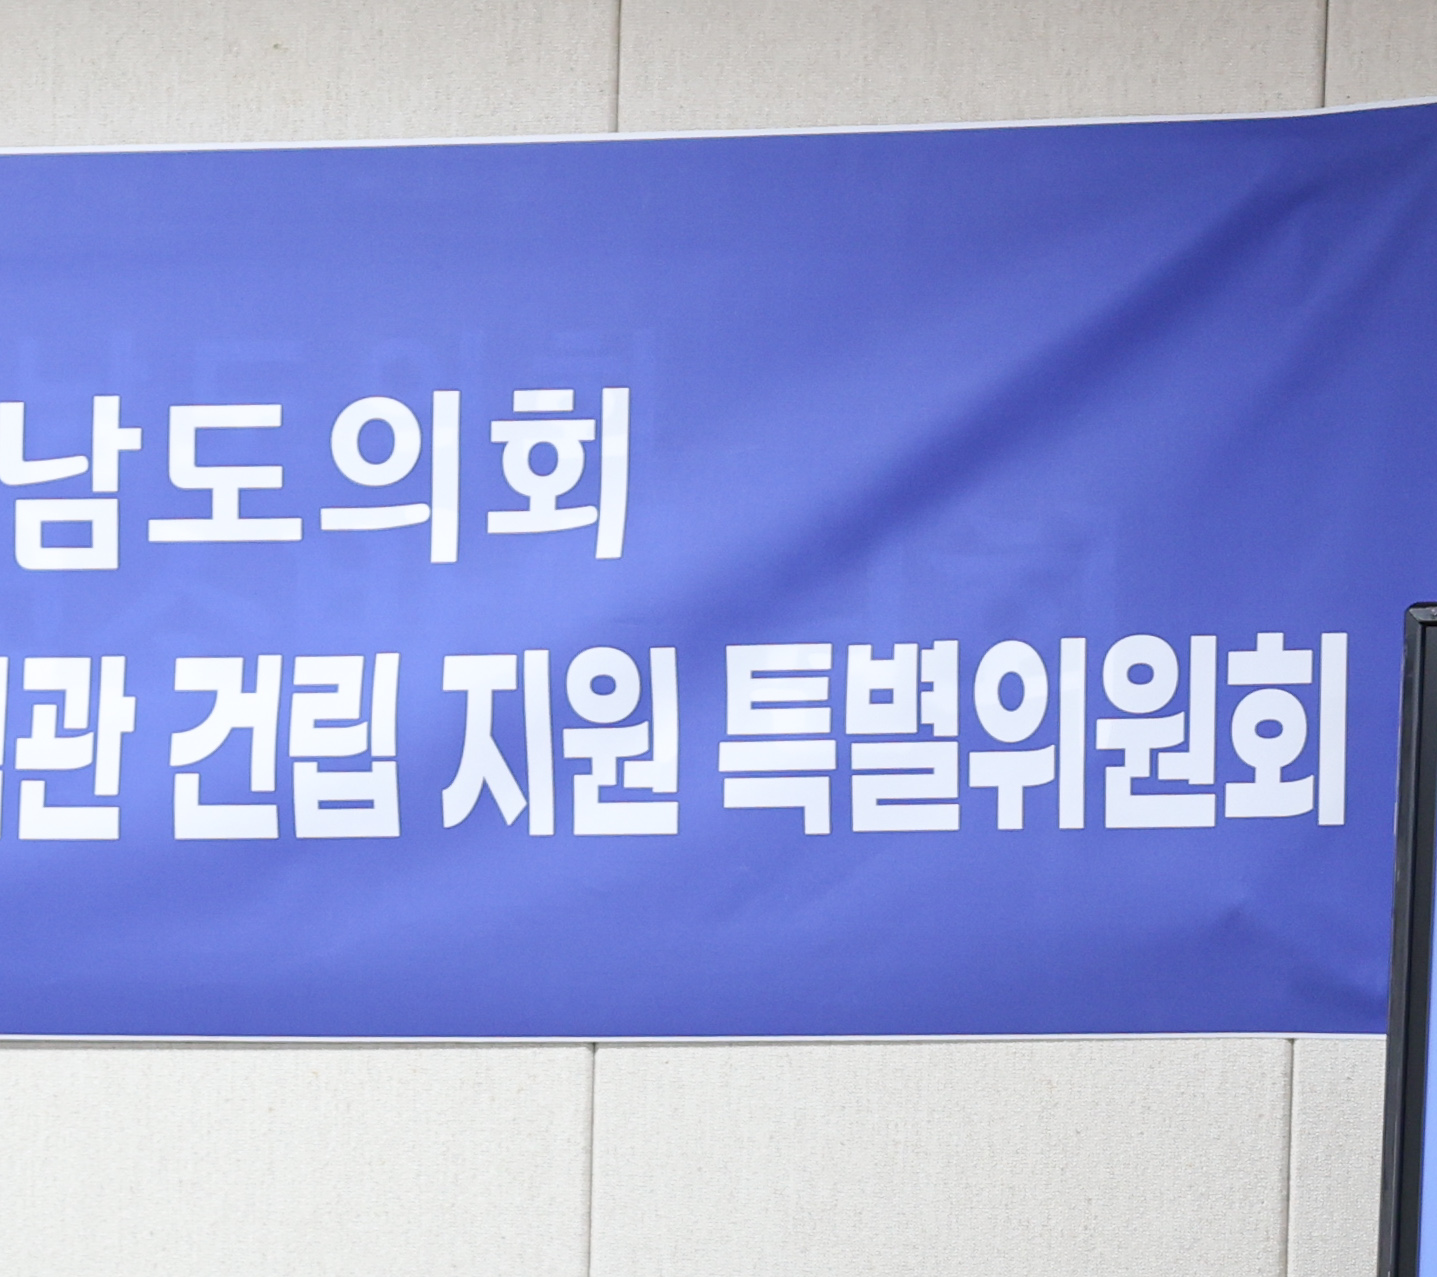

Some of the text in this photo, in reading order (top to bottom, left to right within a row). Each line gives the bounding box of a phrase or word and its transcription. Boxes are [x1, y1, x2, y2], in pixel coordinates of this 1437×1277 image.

[169, 651, 401, 841] 건립
[441, 645, 680, 837] 지원
[718, 631, 1349, 836] 특별위원회
